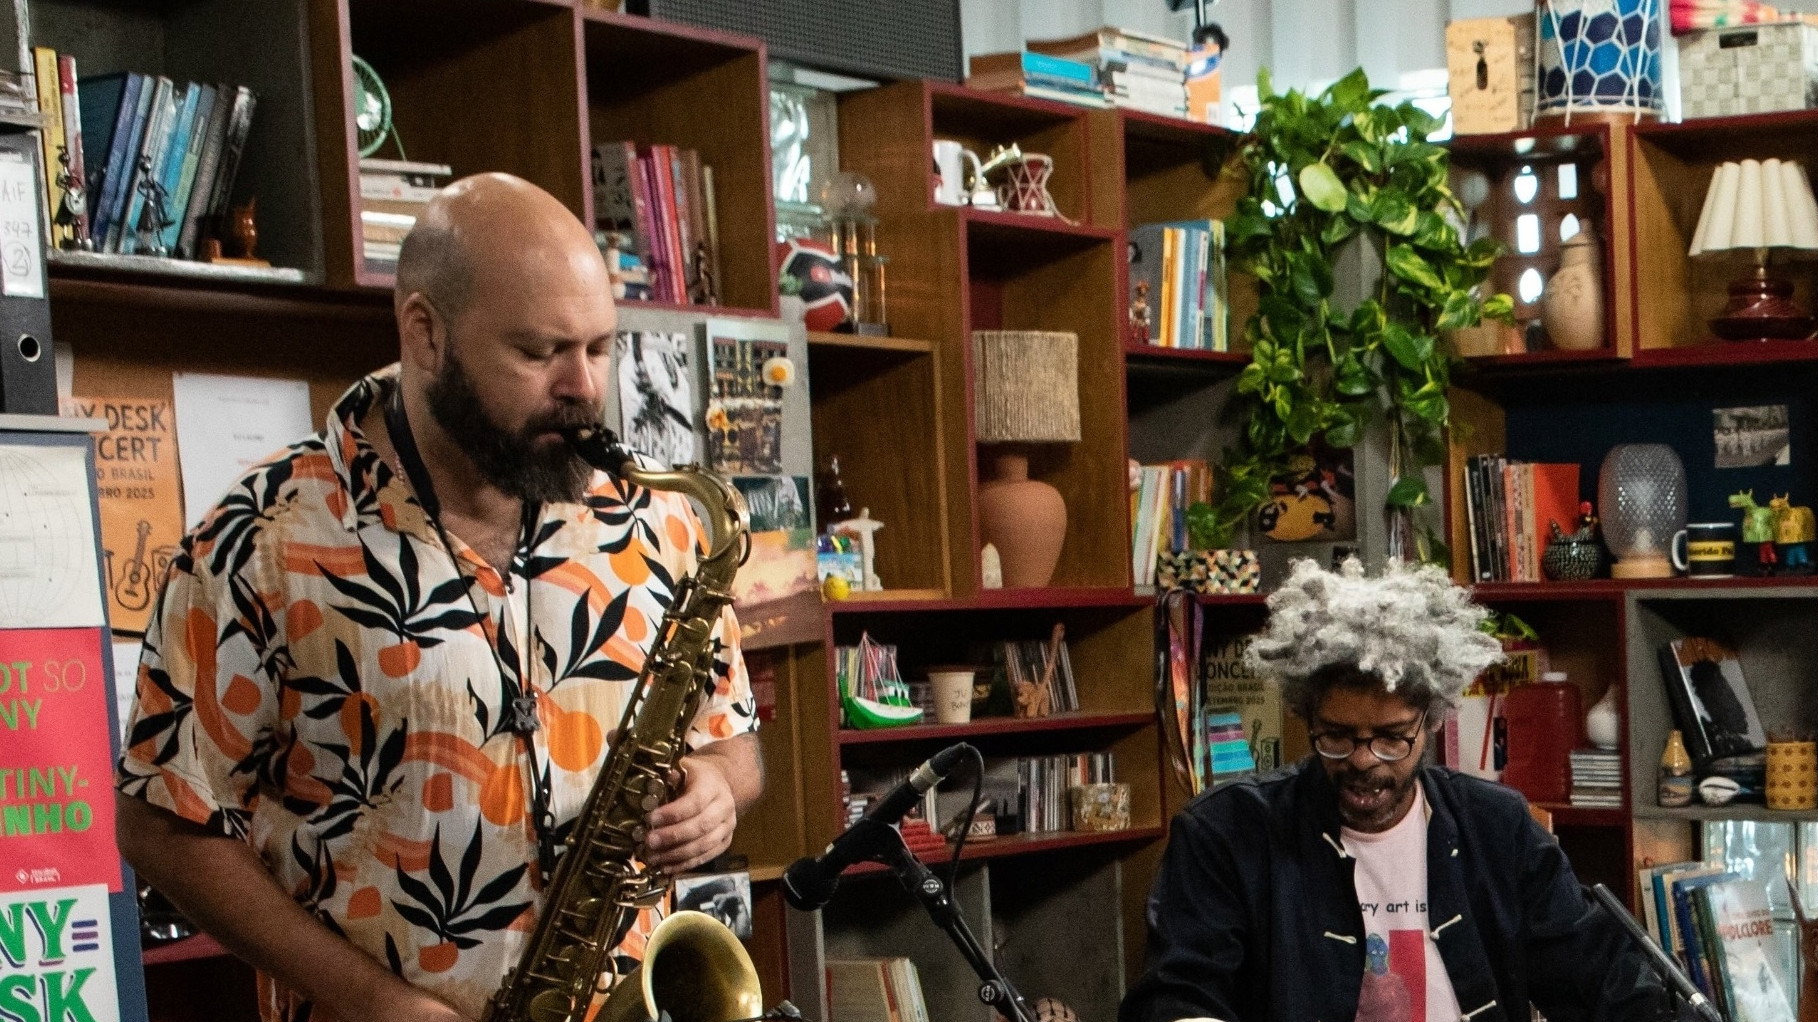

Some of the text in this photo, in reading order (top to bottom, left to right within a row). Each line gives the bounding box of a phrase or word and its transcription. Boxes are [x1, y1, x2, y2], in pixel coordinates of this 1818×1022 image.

[105, 404, 167, 432] DESK
[110, 467, 154, 481] BRASIL
[126, 487, 155, 500] 2025
[43, 658, 87, 694] SO
[1386, 900, 1410, 913] art
[1415, 900, 1427, 913] is
